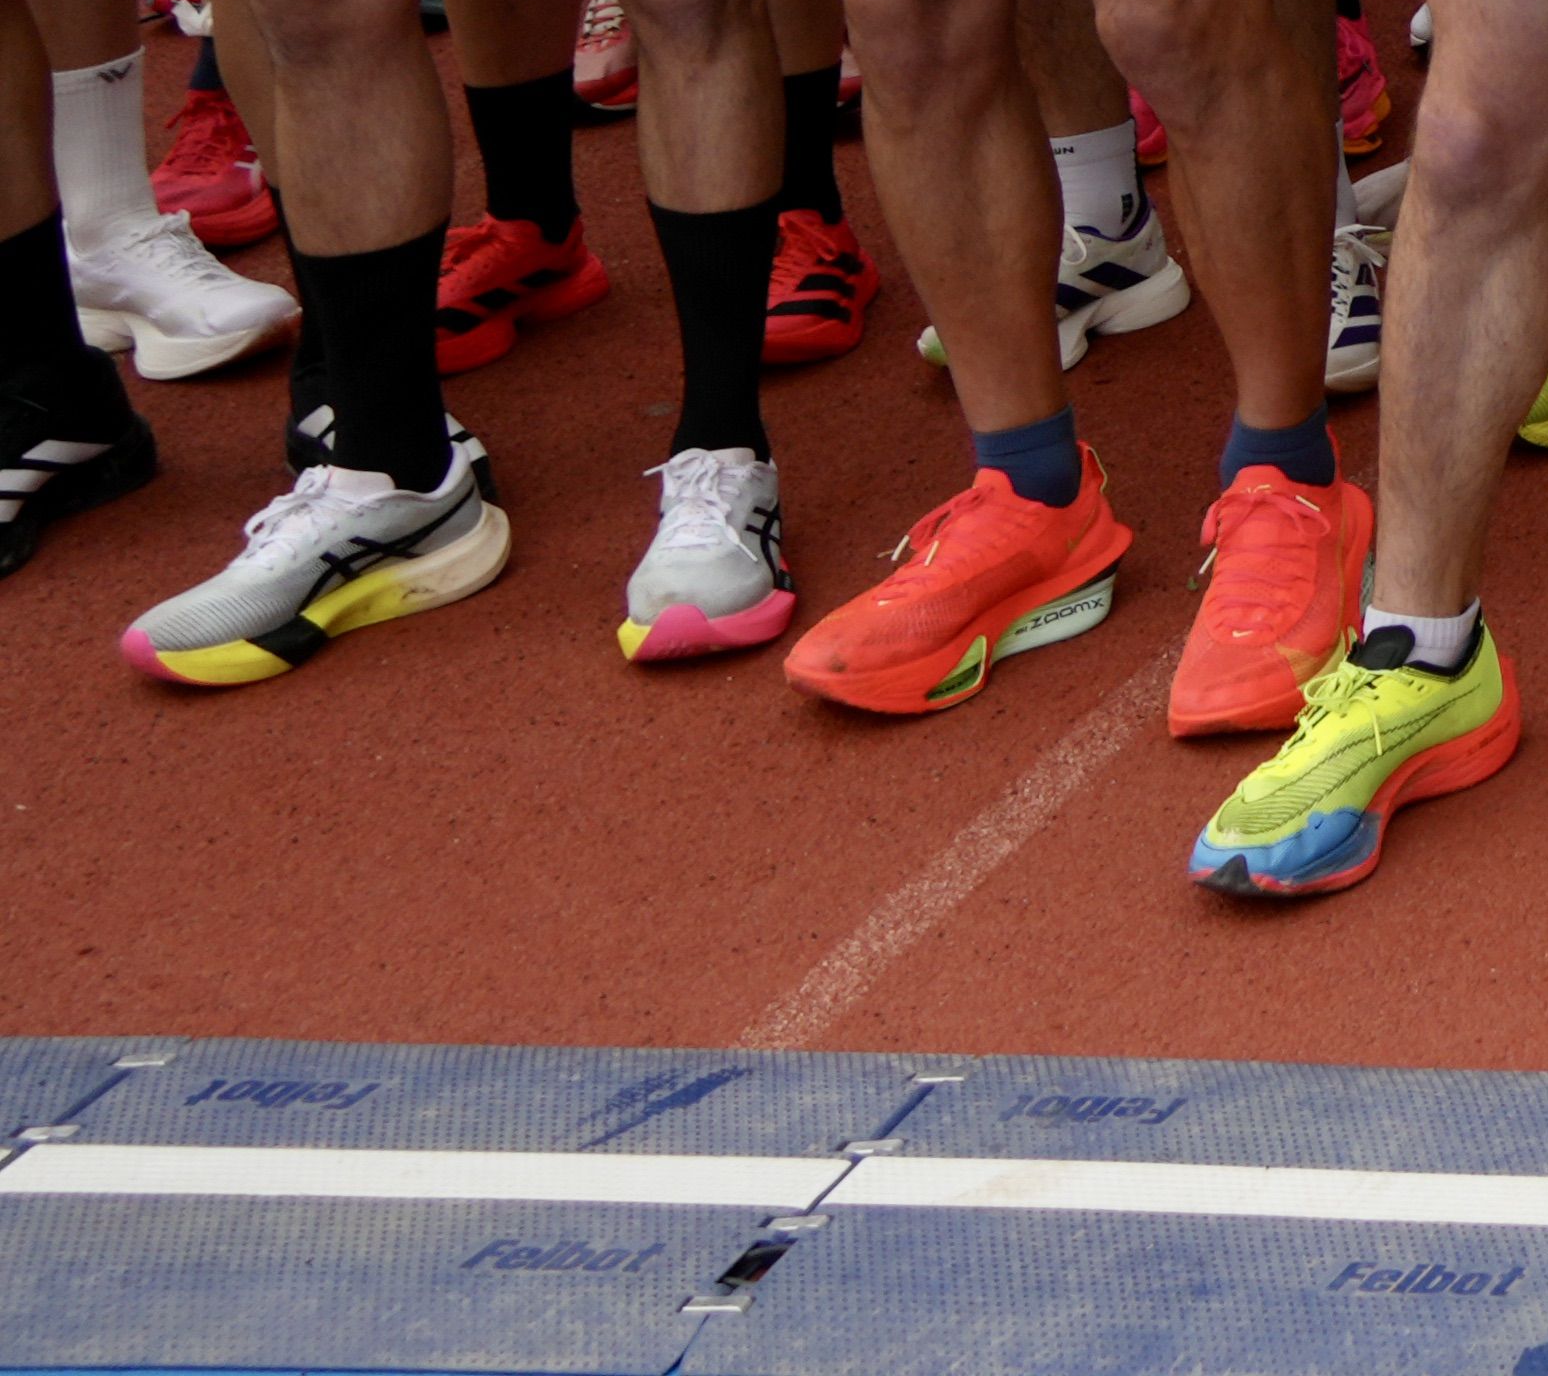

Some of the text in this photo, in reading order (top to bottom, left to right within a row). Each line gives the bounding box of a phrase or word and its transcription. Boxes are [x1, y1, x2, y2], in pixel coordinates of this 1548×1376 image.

[1030, 597, 1104, 631] ZOOMX
[184, 1079, 384, 1110] Felbot
[1326, 1261, 1524, 1298] Felbot
